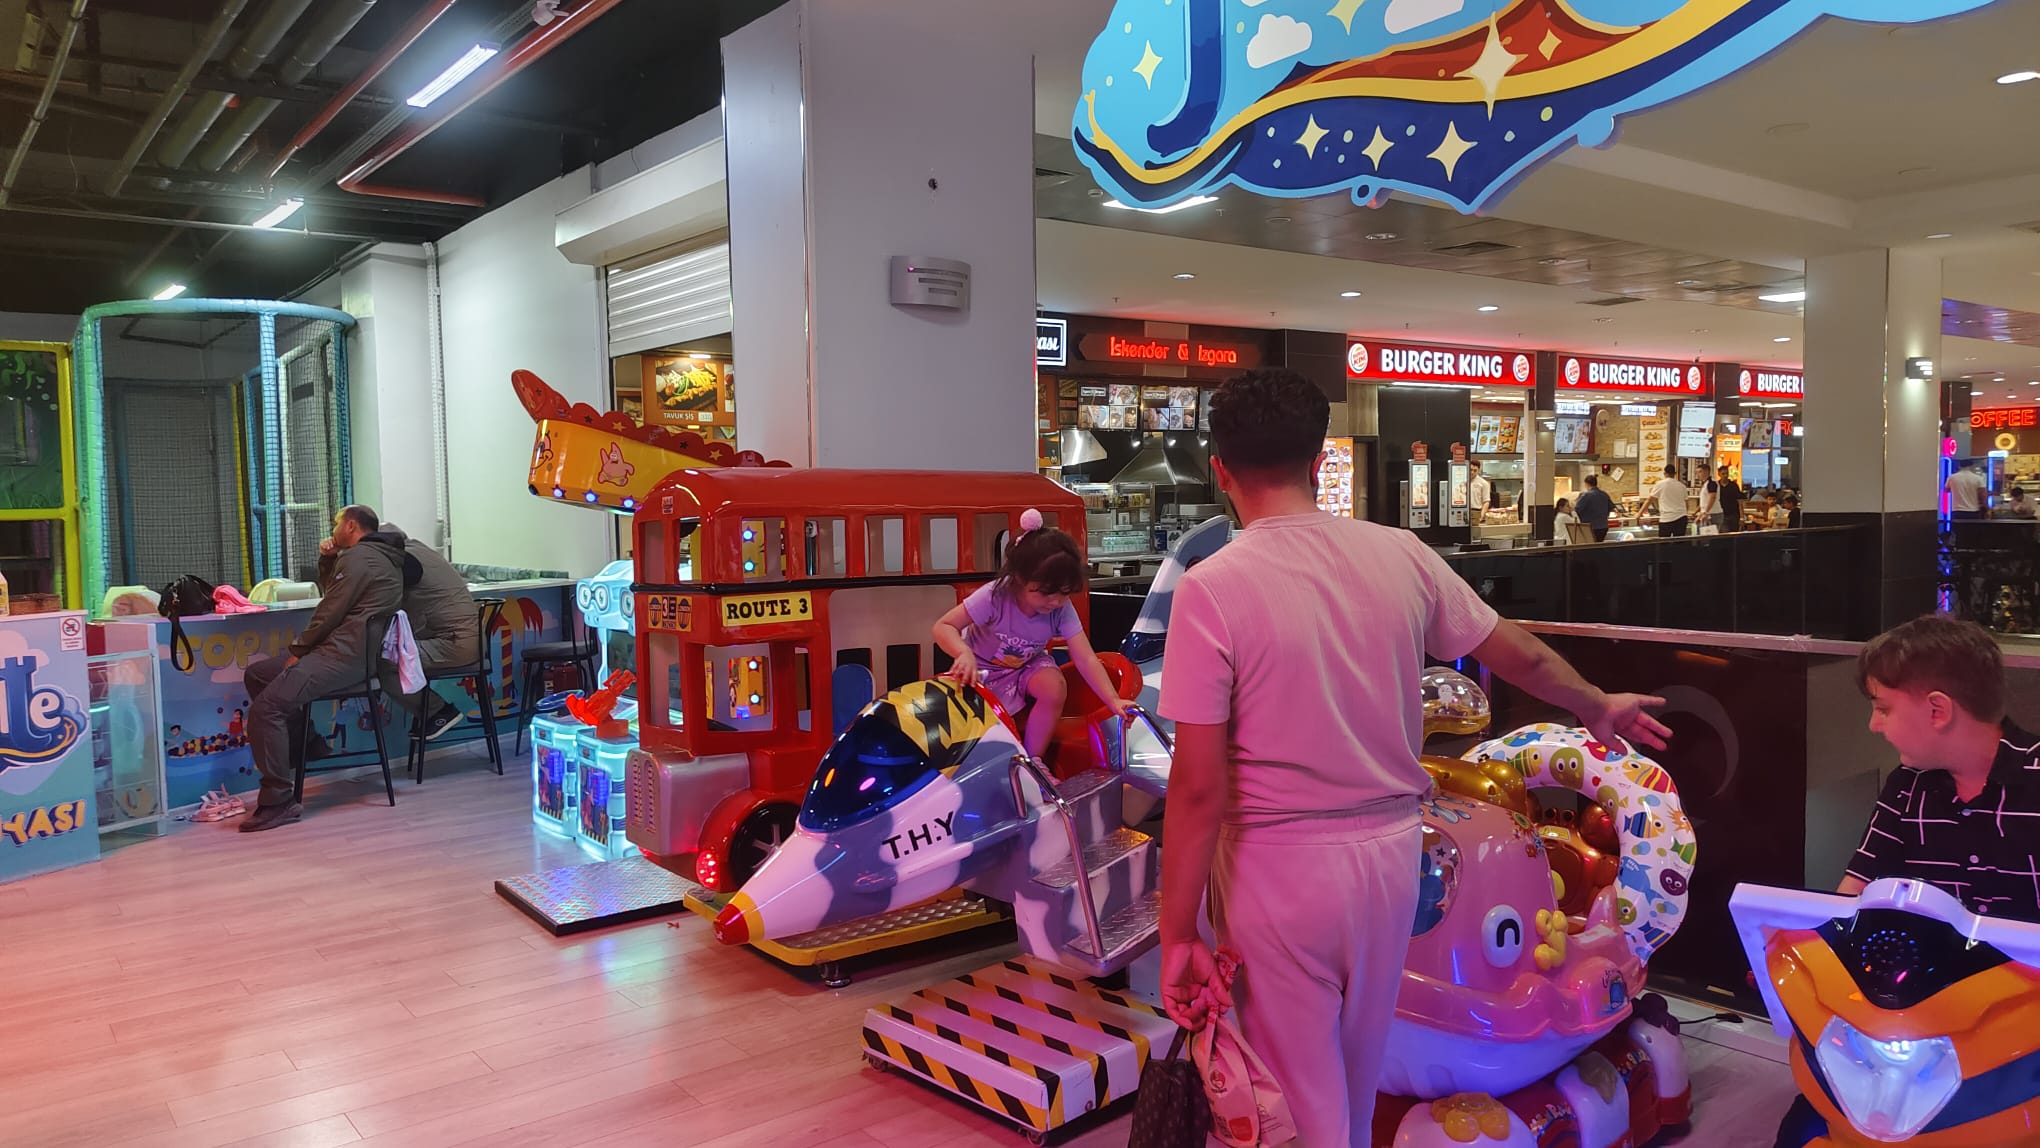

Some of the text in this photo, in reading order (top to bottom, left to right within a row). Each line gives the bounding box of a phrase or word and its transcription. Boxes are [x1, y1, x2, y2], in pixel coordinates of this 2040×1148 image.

[1198, 344, 1237, 366] Izgara
[1381, 348, 1503, 378] BURGER KING
[1588, 362, 1645, 386] BURGER
[1647, 366, 1681, 388] KING
[1757, 373, 1800, 394] BURGER
[726, 598, 808, 619] ROUTE 3
[176, 629, 260, 676] TOP
